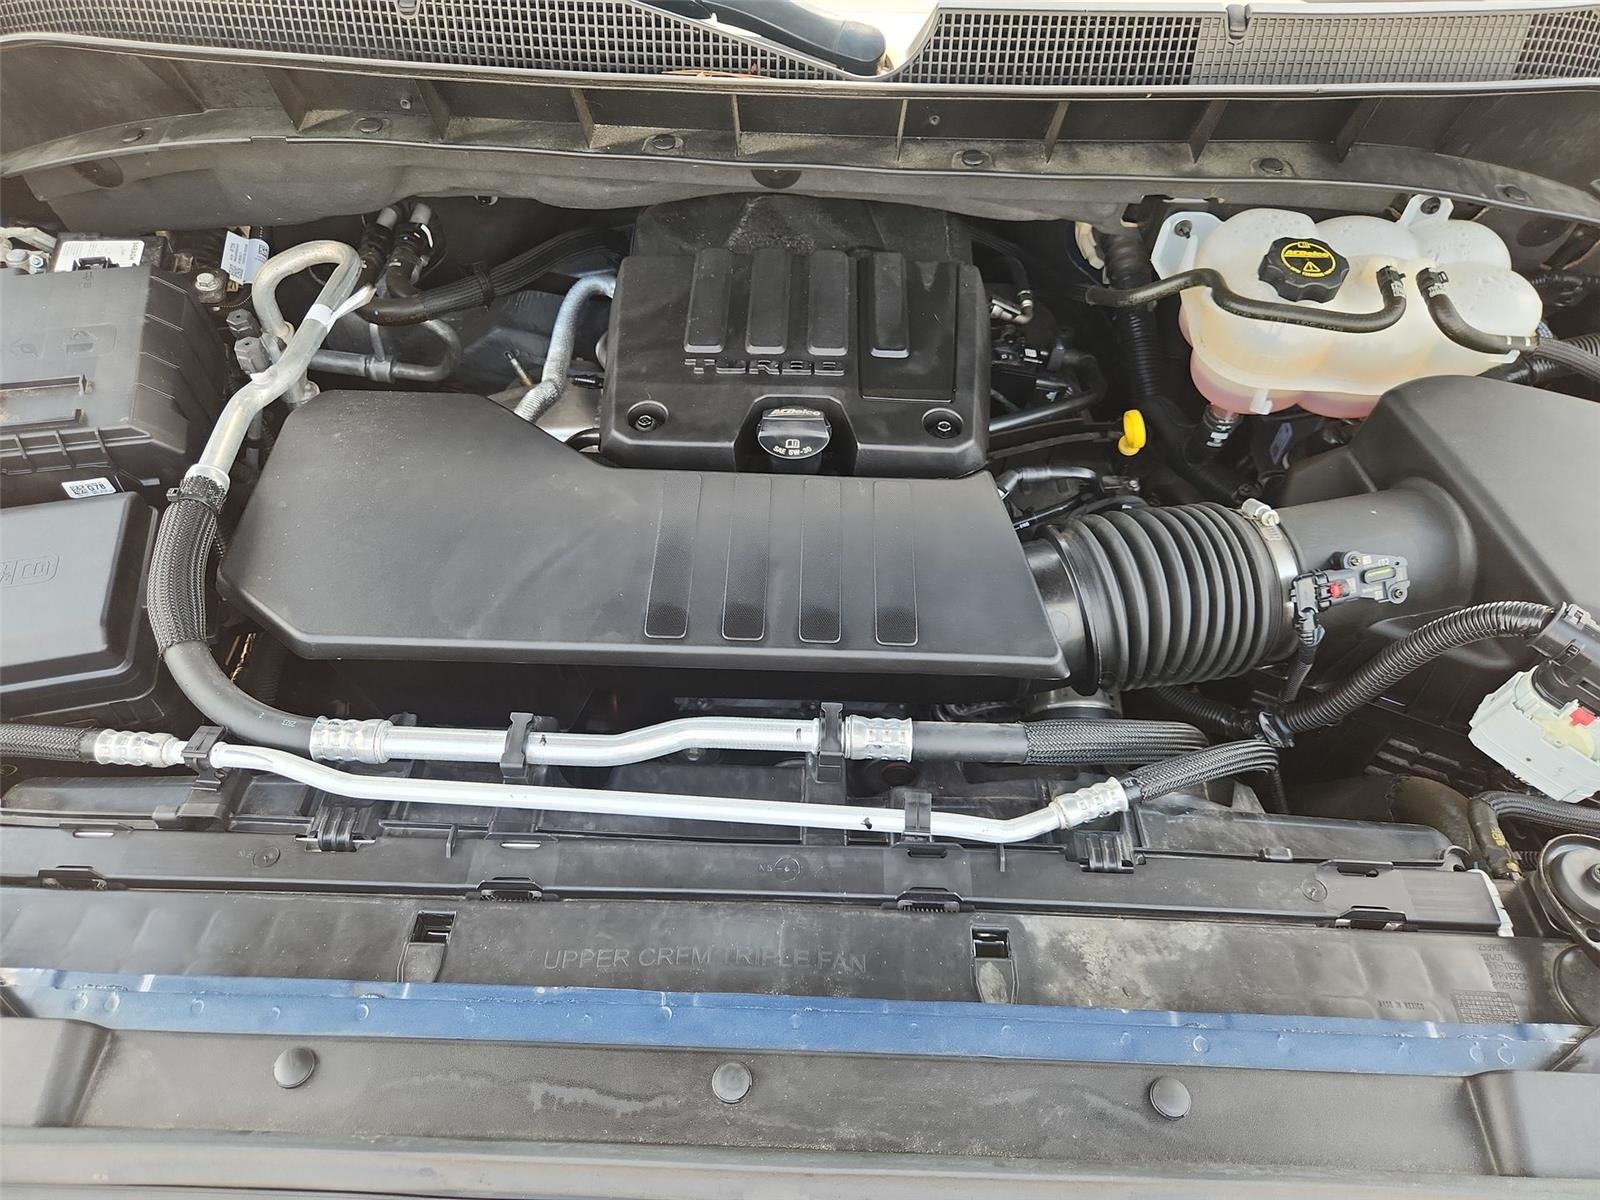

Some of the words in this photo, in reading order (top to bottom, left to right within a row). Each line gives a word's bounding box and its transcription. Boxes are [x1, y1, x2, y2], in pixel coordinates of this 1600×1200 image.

[684, 358, 846, 377] TURBO
[768, 408, 821, 417] ACDelco
[773, 445, 786, 456] SAE
[543, 947, 630, 970] UPPER
[719, 945, 809, 968] TRIPLE
[818, 949, 867, 973] FAN
